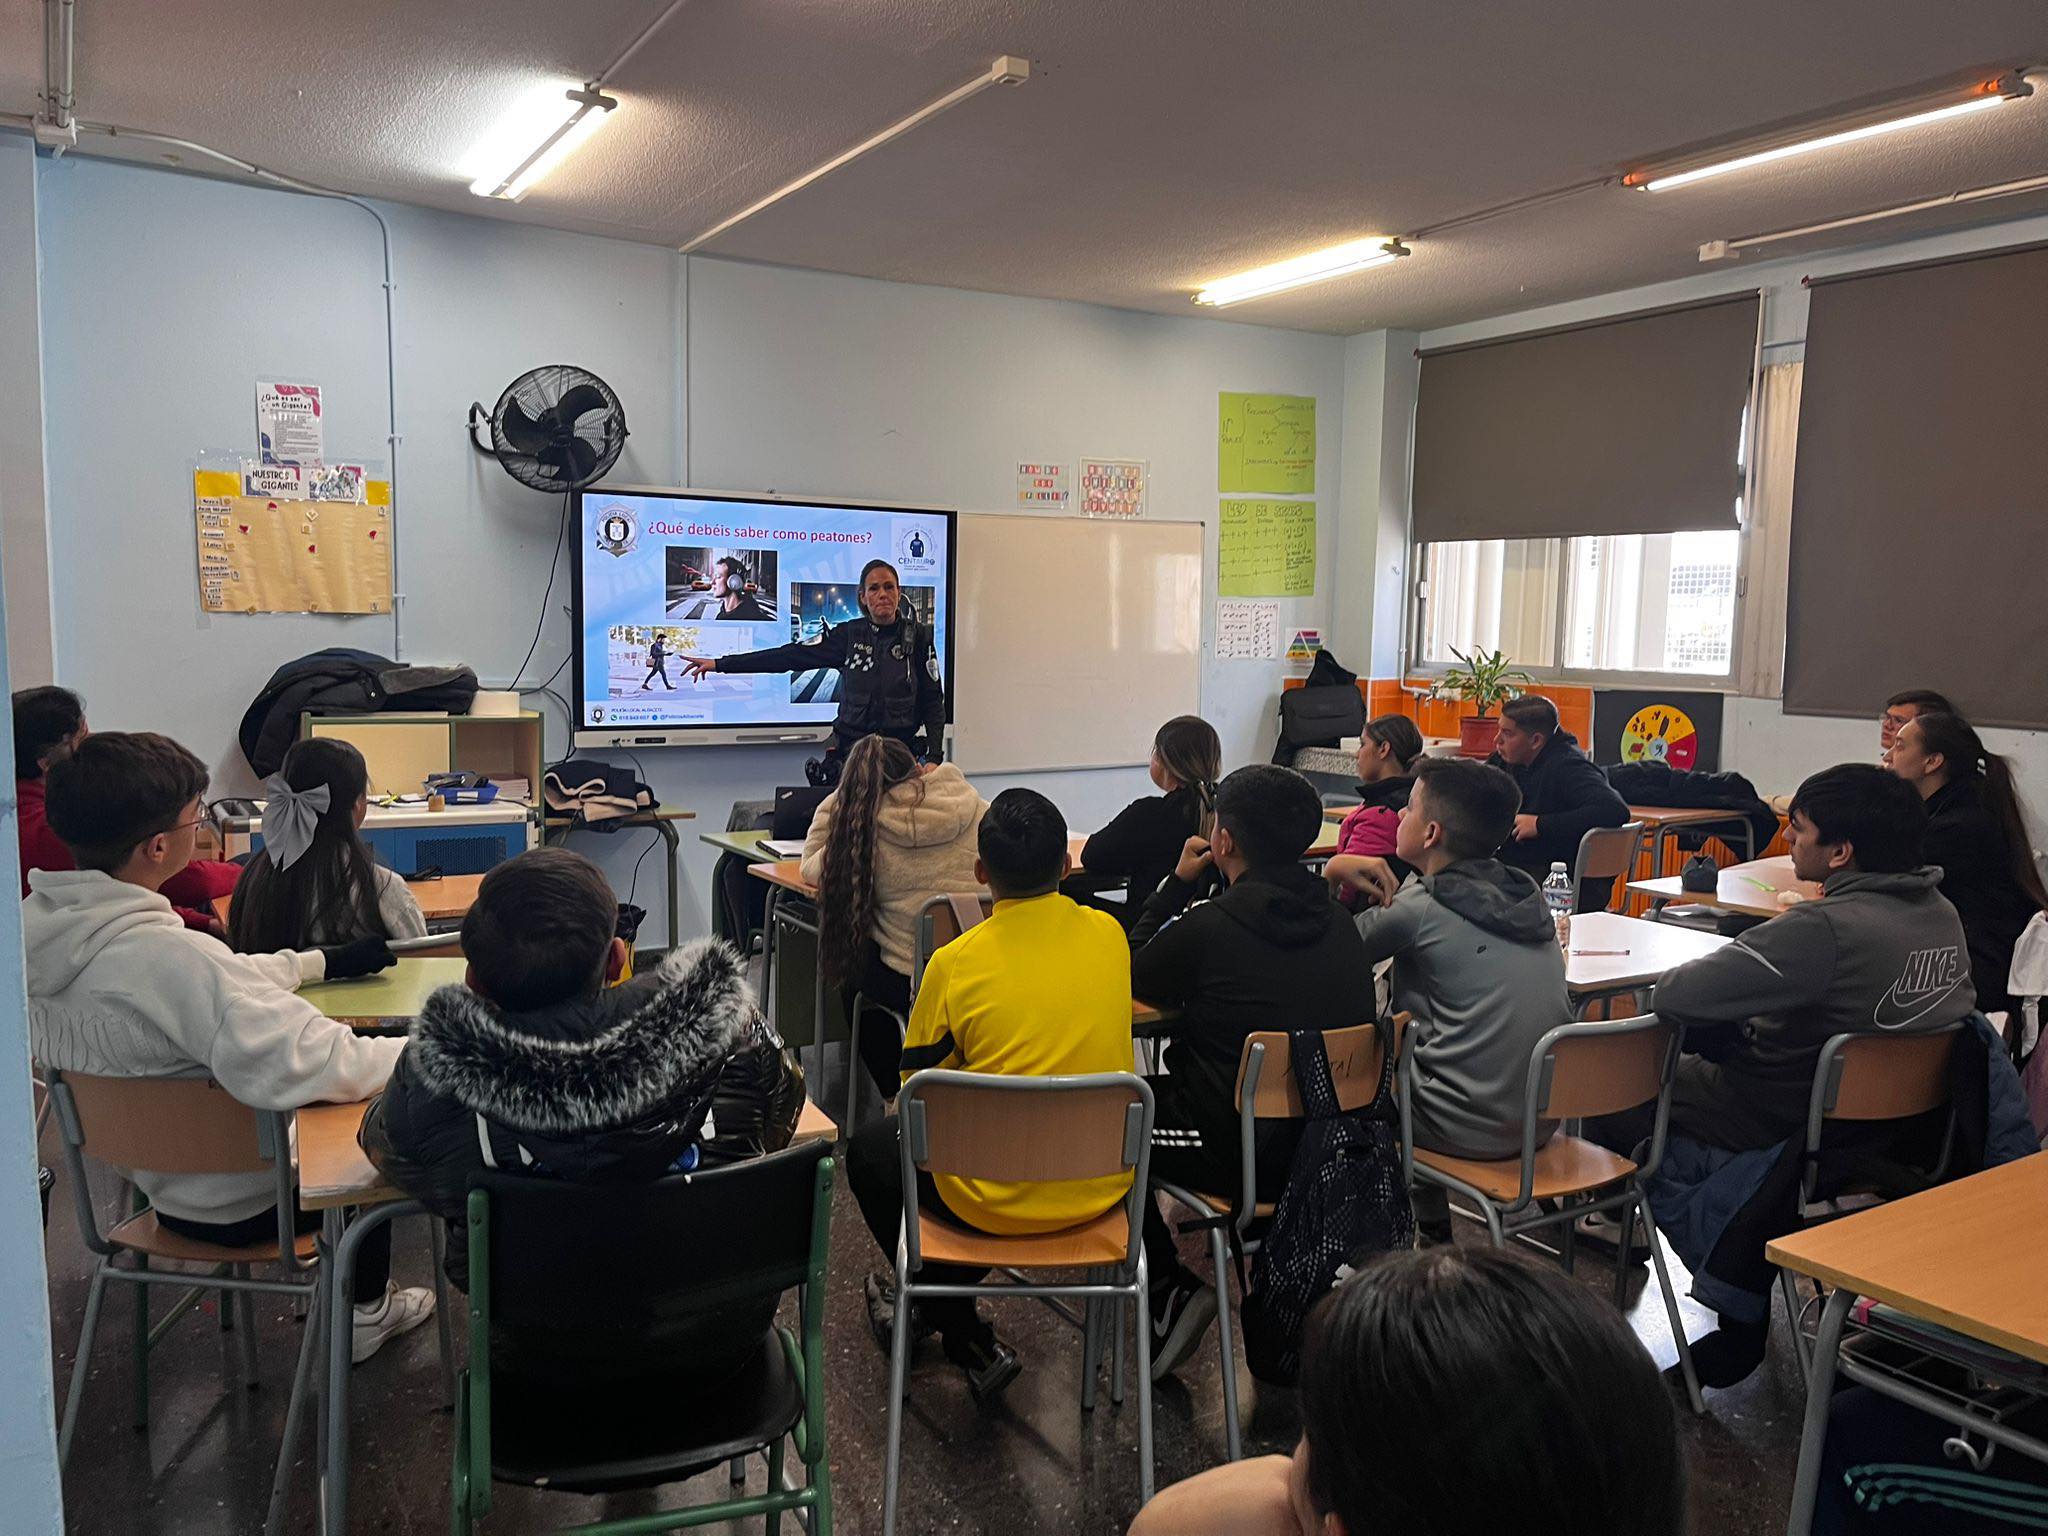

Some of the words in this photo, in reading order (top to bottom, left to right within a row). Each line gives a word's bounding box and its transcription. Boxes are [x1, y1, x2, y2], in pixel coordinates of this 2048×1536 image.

[281, 402, 312, 410] Gigante?
[261, 481, 299, 491] GIGANTES
[648, 521, 683, 534] ¿Qué
[688, 523, 730, 537] debéis
[734, 525, 769, 539] saber
[773, 530, 807, 541] como
[811, 531, 872, 544] peatones?
[1897, 946, 1957, 994] NIKE
